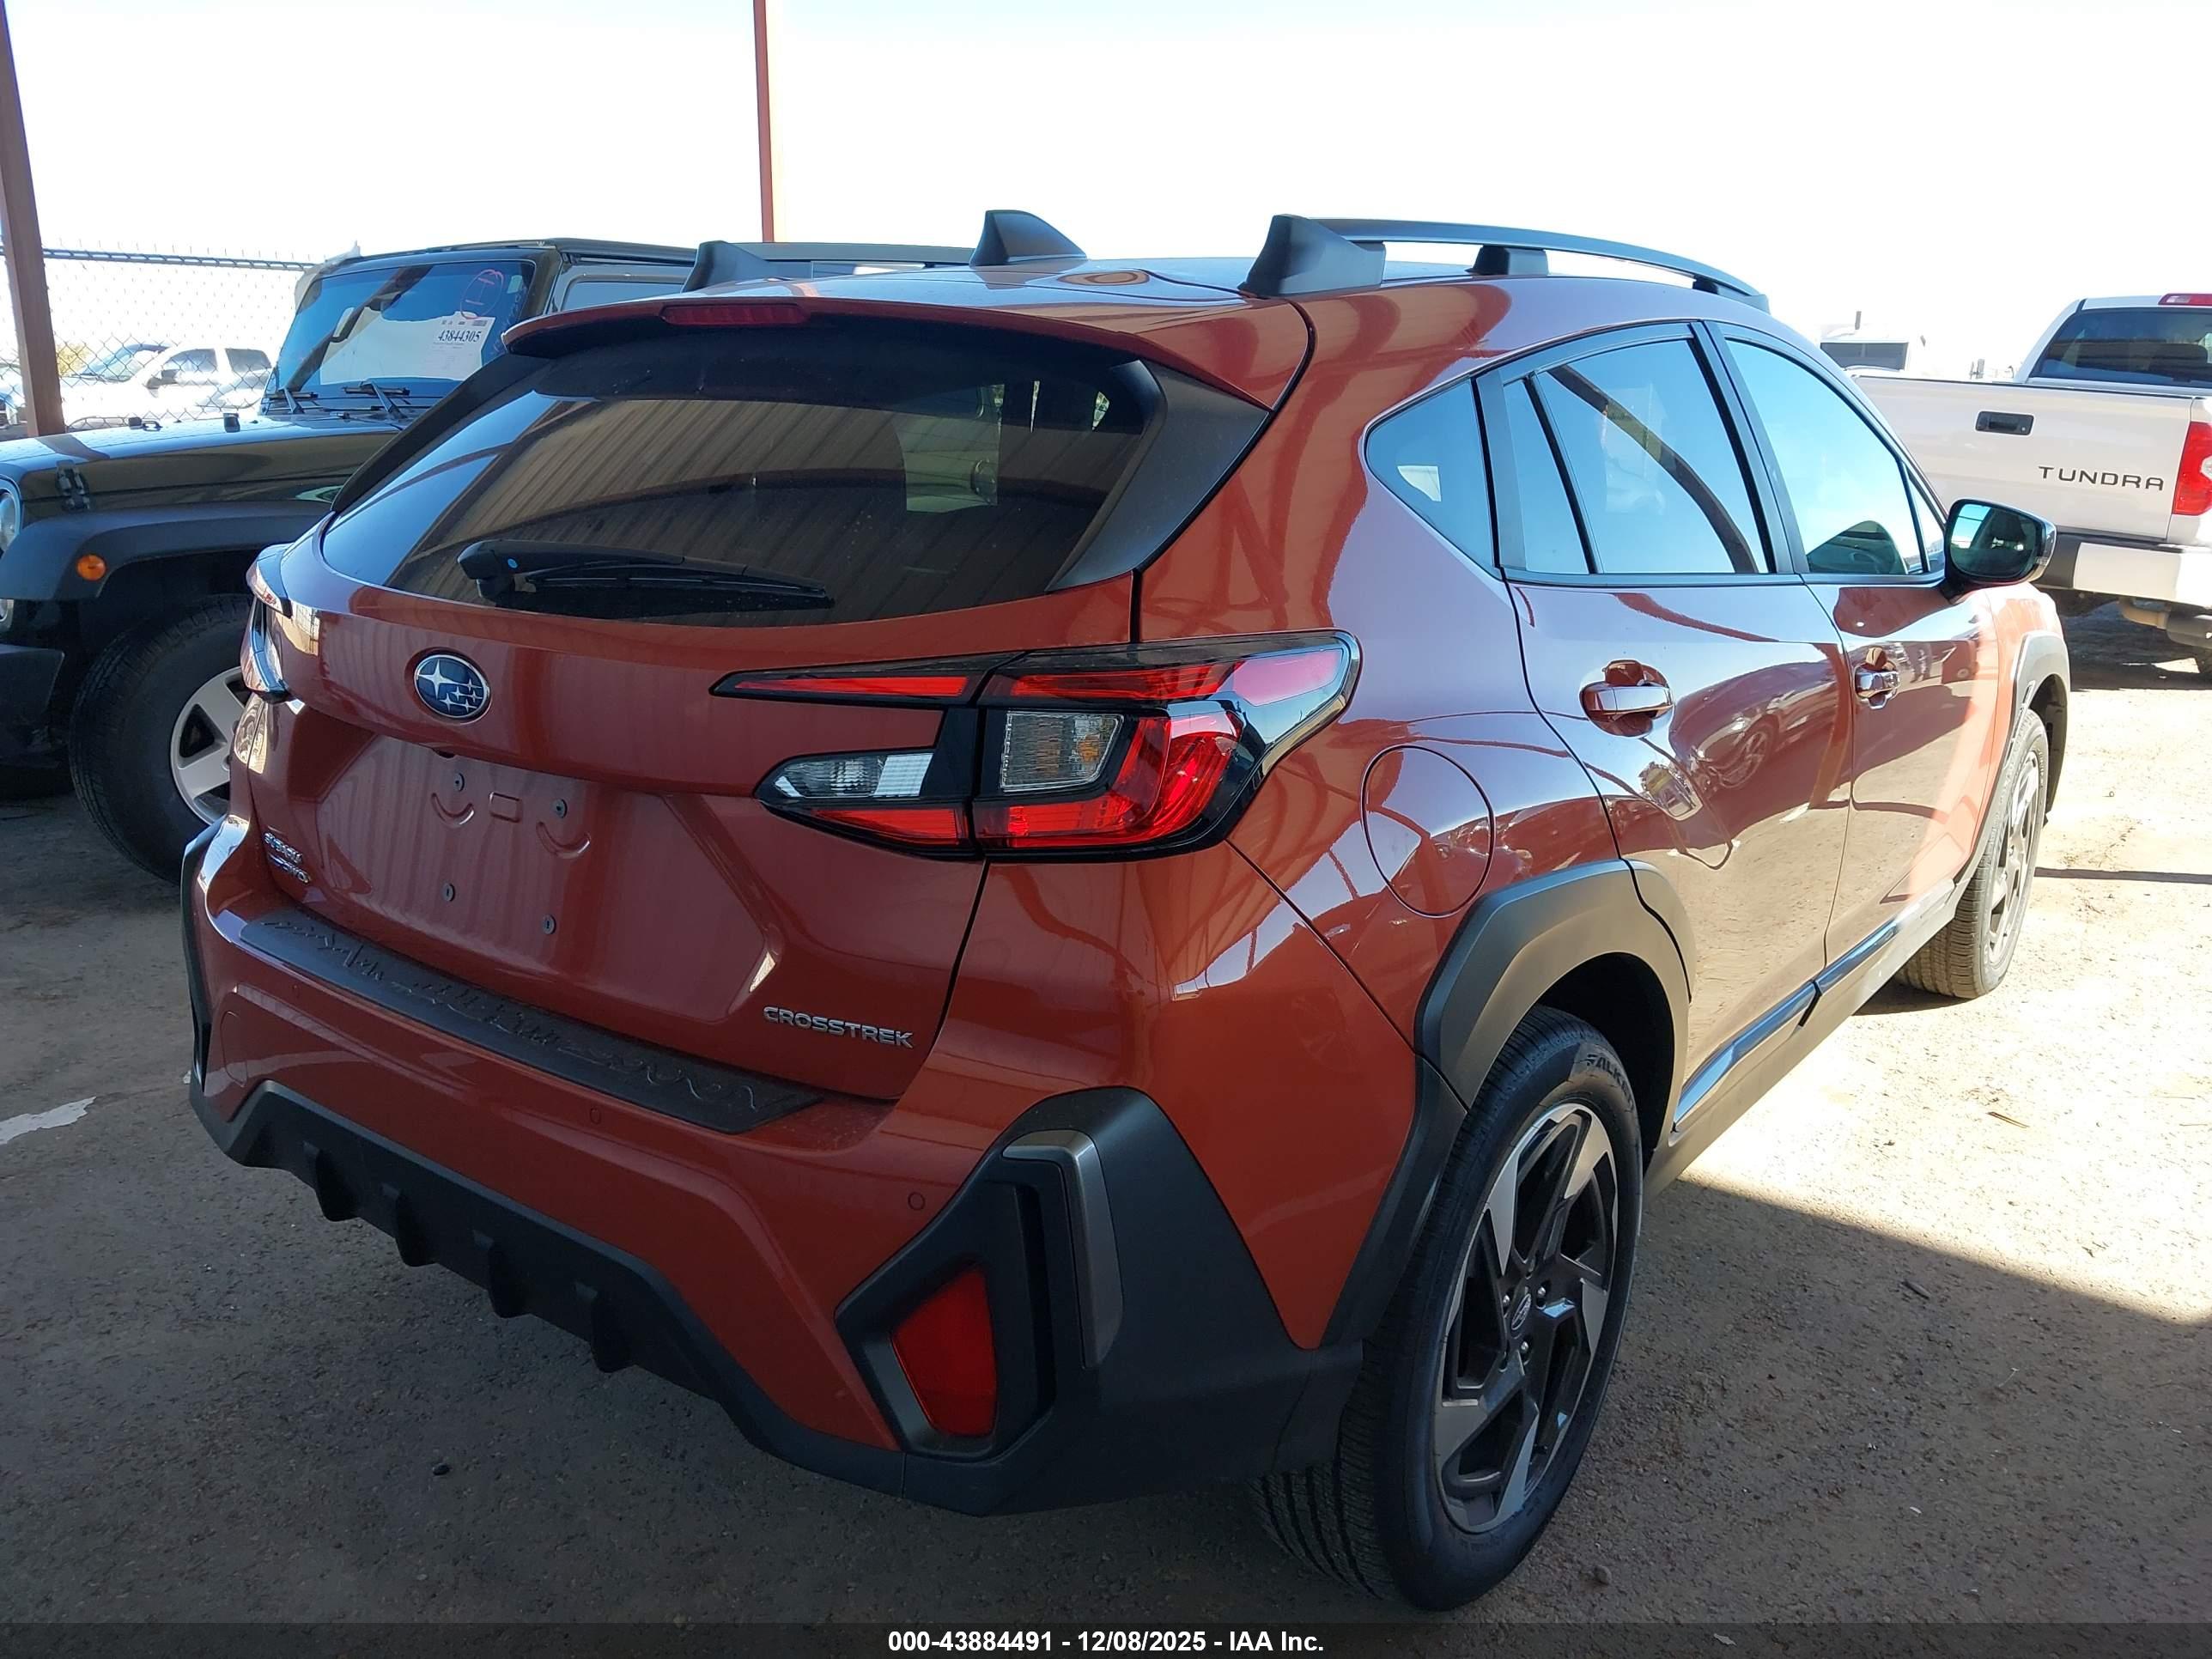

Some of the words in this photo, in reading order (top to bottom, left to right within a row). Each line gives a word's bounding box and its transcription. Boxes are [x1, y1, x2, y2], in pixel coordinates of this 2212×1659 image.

[438, 329, 481, 343] 43844305
[2039, 465, 2164, 491] TUNDRA
[763, 1006, 914, 1048] CROSSTREK
